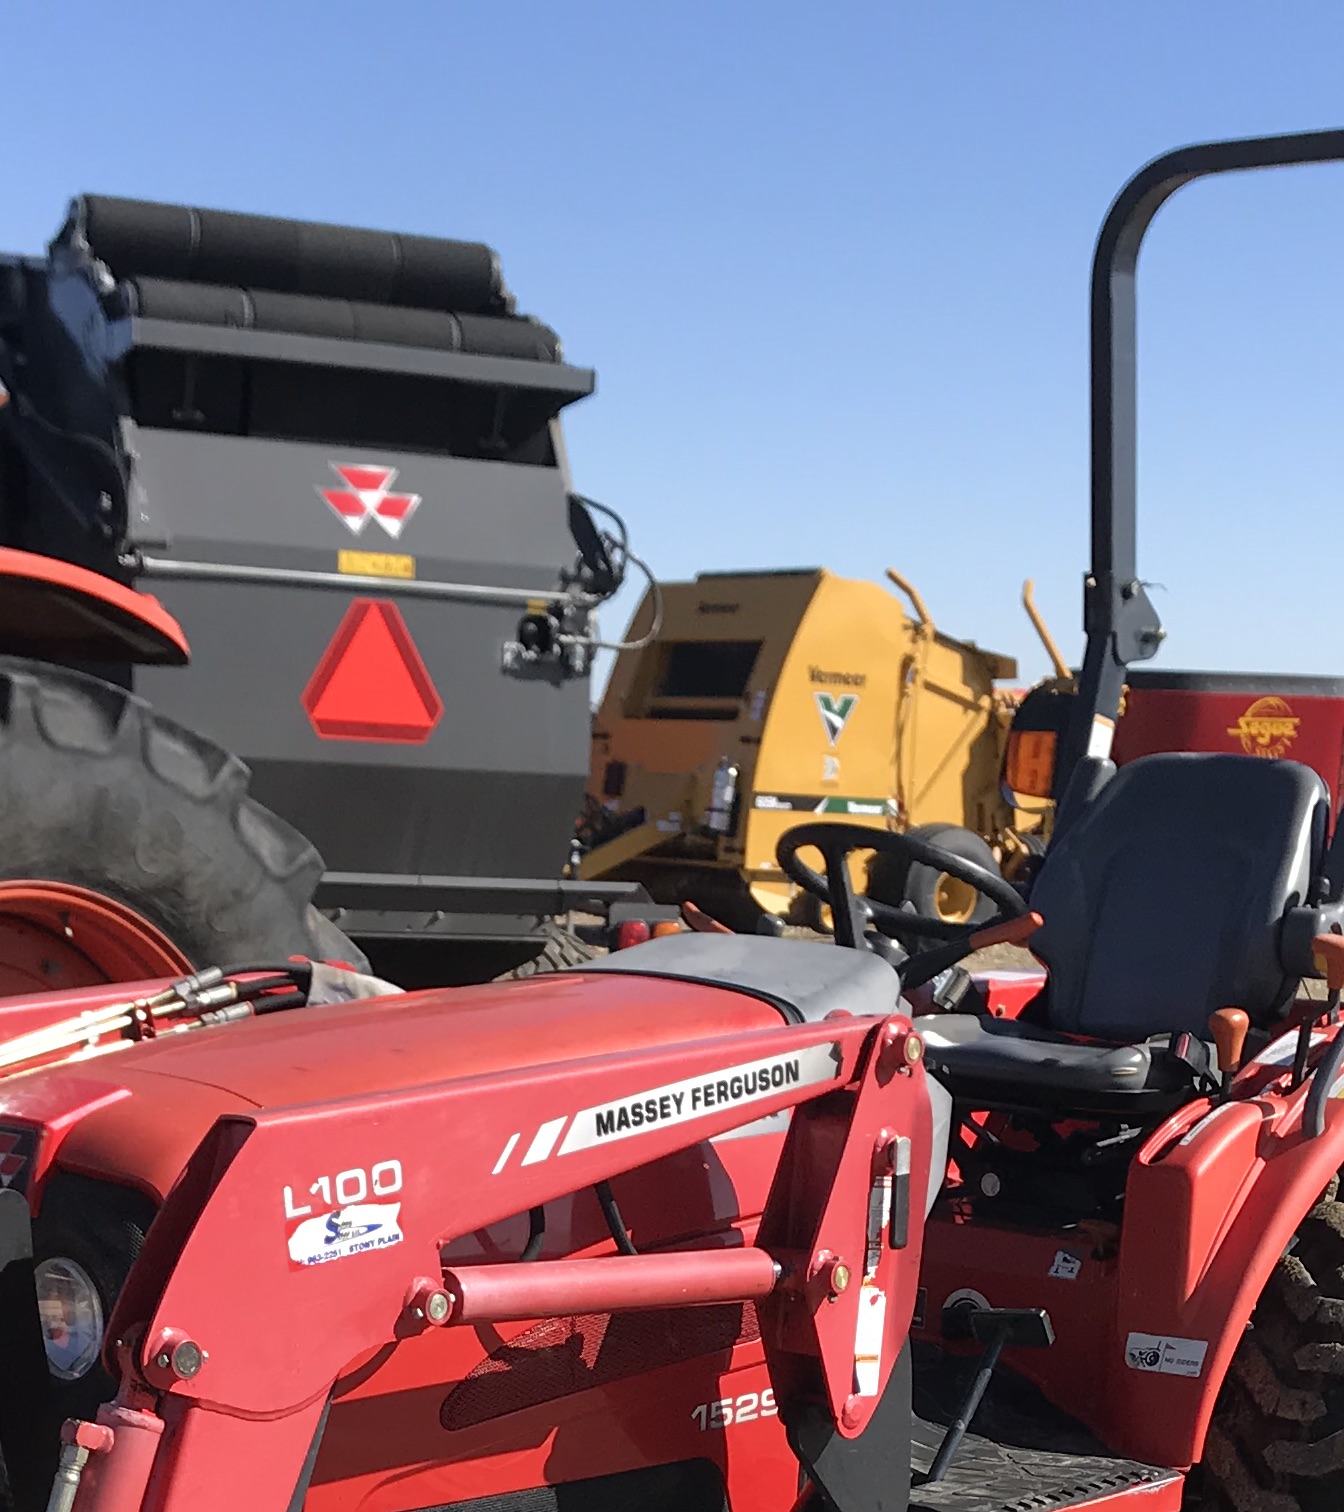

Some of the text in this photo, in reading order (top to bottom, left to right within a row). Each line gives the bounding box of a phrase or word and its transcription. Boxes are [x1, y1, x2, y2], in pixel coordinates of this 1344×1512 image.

[595, 1058, 800, 1137] MASSEY FERGUSON
[283, 1159, 403, 1219] L100
